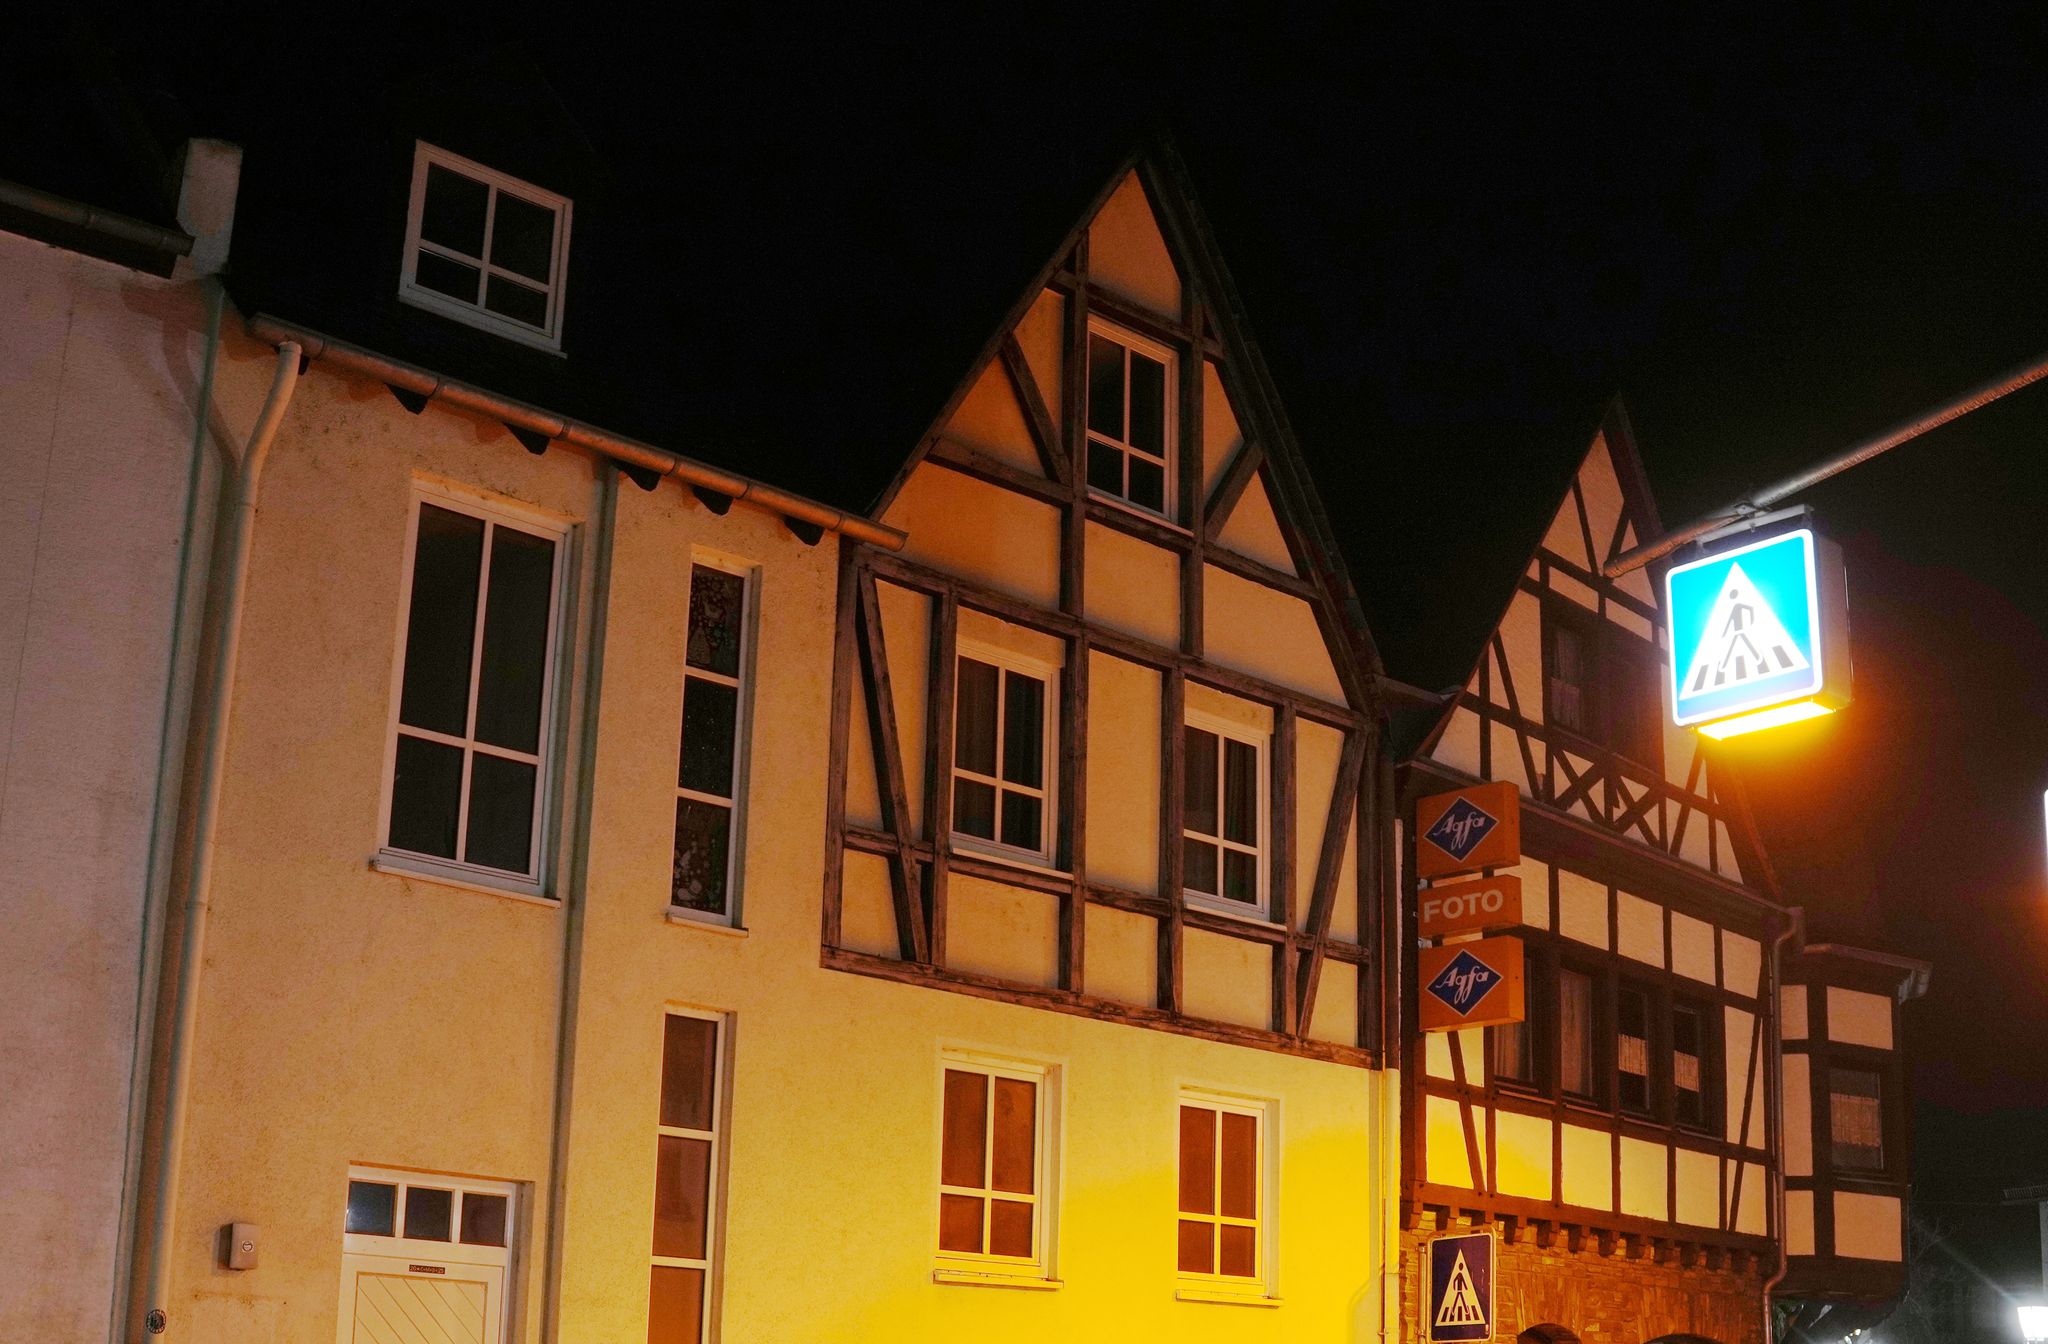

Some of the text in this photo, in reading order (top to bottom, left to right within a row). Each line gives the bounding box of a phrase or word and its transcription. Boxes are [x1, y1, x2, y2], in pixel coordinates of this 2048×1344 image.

[1433, 811, 1485, 850] Agfa
[1423, 889, 1504, 923] FOTO
[1435, 966, 1489, 1004] Agfa
